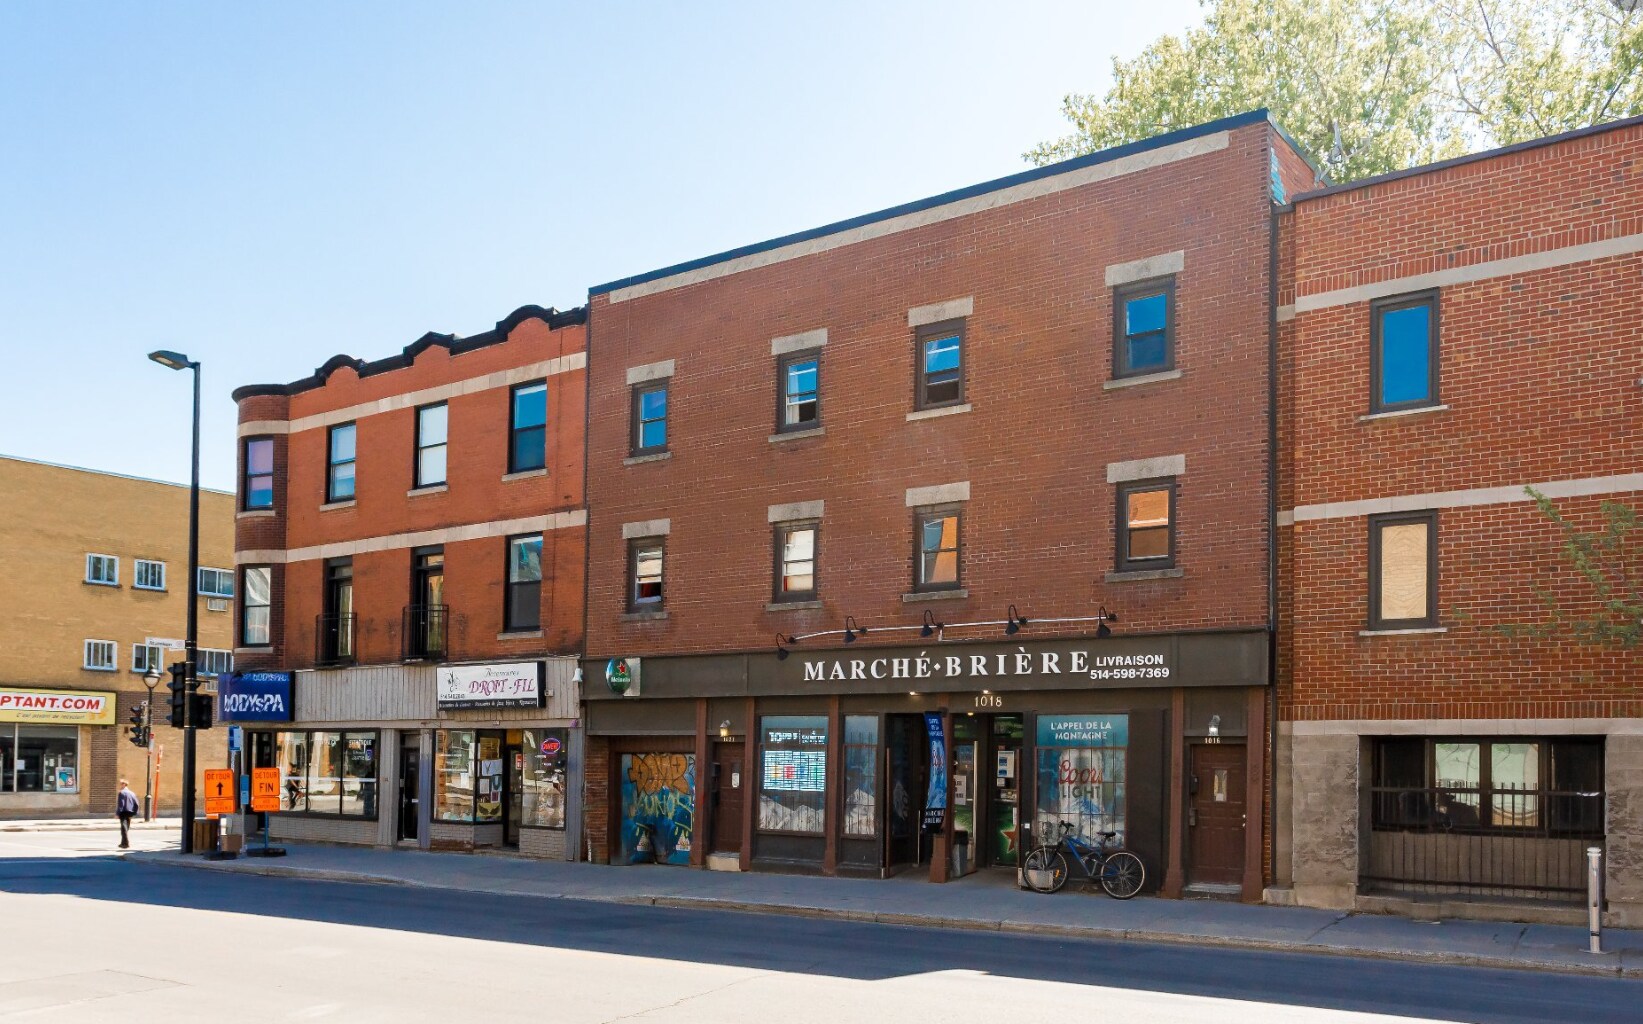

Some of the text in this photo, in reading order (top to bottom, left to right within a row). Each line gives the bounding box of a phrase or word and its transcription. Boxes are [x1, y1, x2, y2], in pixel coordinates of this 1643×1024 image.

[804, 647, 1089, 681] MARCHÉ BRIÈRE
[1096, 655, 1164, 667] LIVRAISON
[1089, 667, 1170, 680] 514-598-7369
[974, 695, 1002, 708] 1018
[1050, 721, 1112, 730] L'APPEL DE LA
[1055, 731, 1108, 740] MONTAGNE
[1059, 760, 1103, 784] Coors
[260, 782, 274, 792] FIN
[1061, 785, 1101, 798] LIGHT
